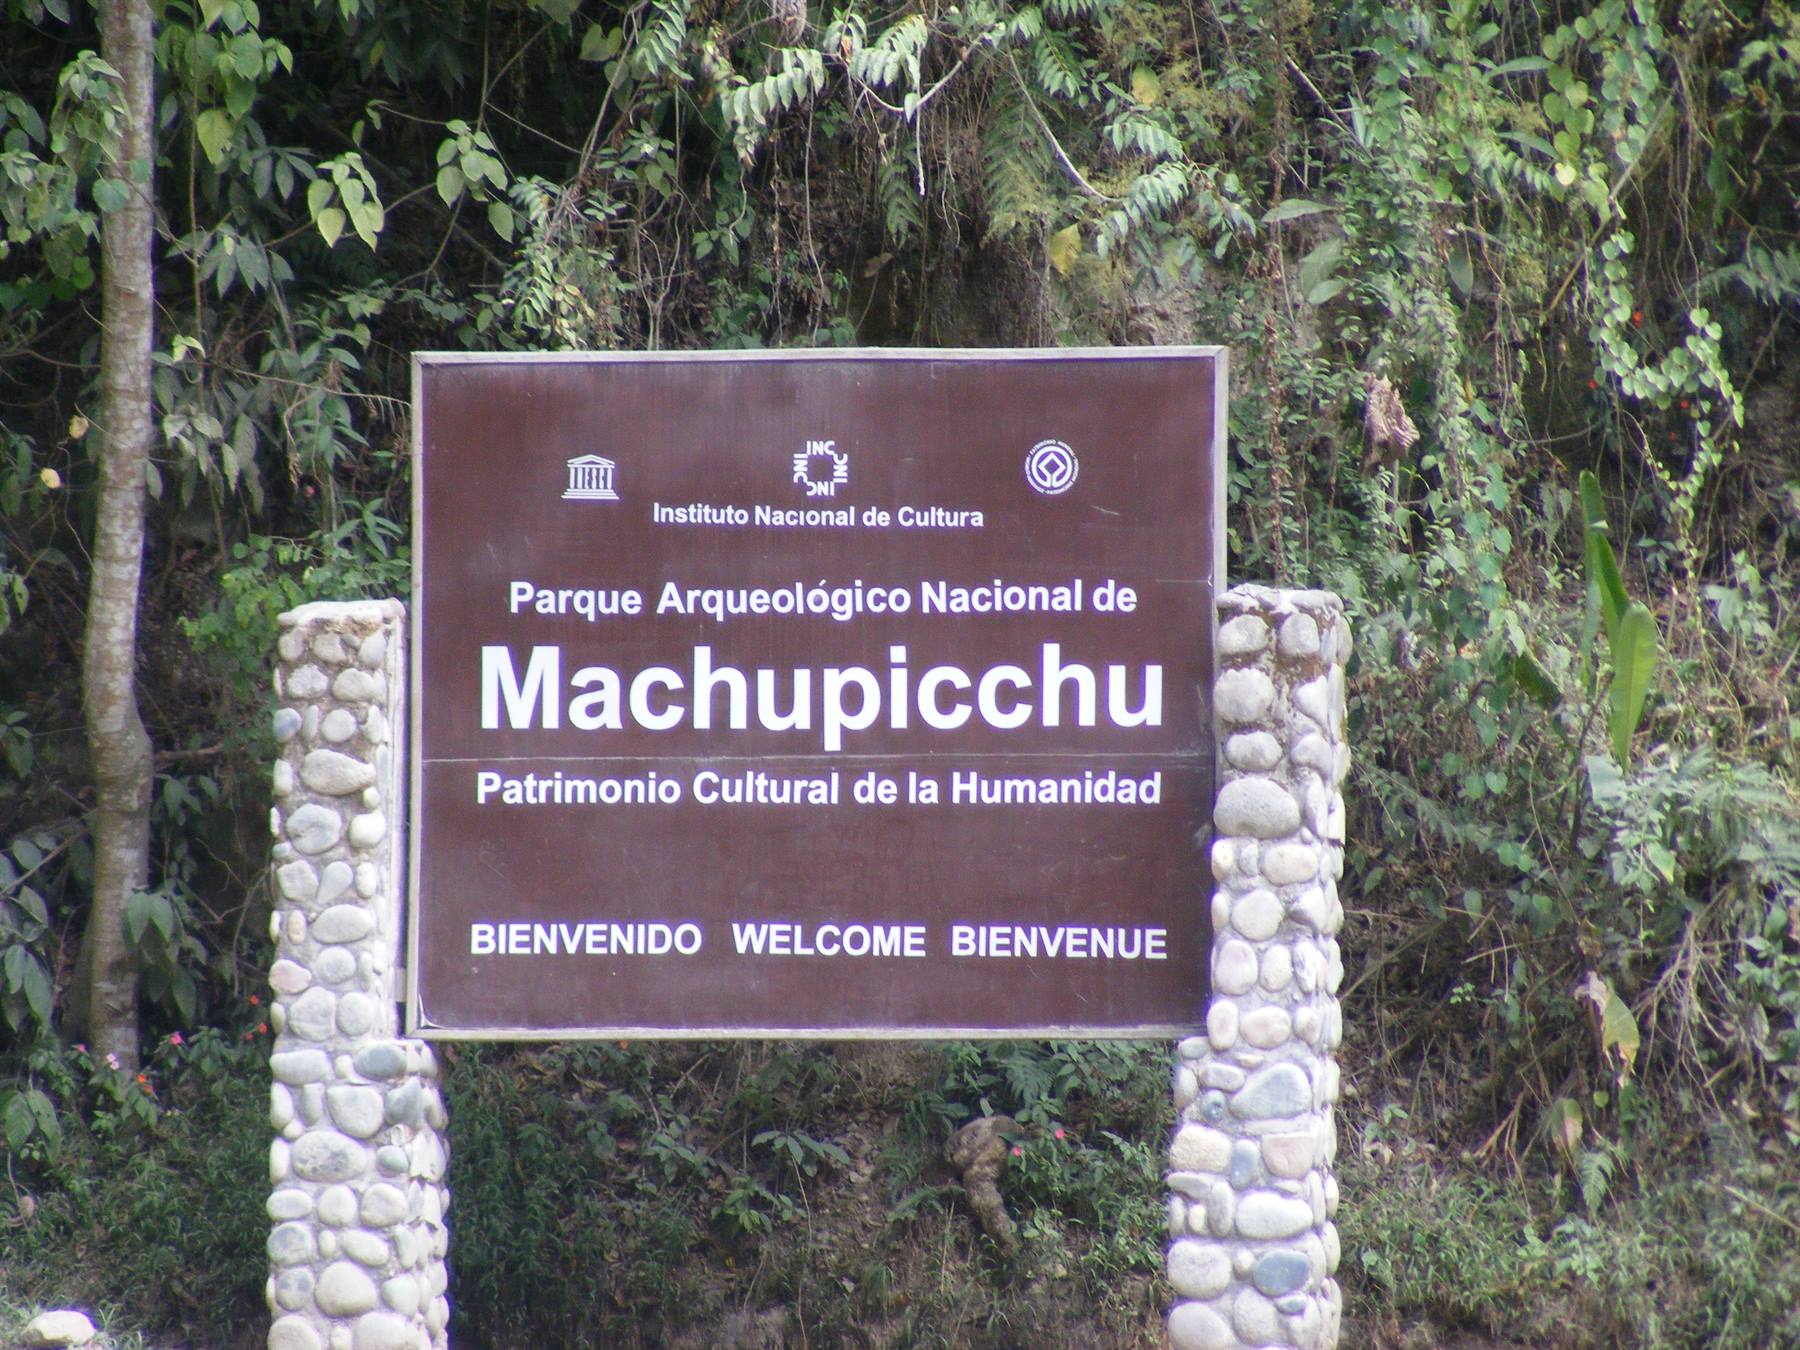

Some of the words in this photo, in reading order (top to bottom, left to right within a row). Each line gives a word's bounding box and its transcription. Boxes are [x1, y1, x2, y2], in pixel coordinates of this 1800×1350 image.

[806, 440, 836, 456] INC
[793, 453, 808, 483] INC
[833, 453, 848, 483] INC
[653, 502, 749, 525] Instituto
[754, 505, 855, 527] Nacional
[862, 506, 891, 527] de
[897, 506, 985, 528] Cultura
[510, 581, 642, 623] Parque
[656, 579, 912, 623] Arqueológico
[921, 578, 1083, 614] Nacional
[1092, 579, 1138, 613] de
[481, 642, 1163, 752] Machupicchu
[477, 771, 682, 805] Patrimonio
[692, 770, 839, 805] Cultural
[853, 771, 898, 805] de
[908, 771, 939, 805] la
[952, 770, 1162, 805] Humanidad
[470, 923, 702, 955] BIENVENIDO
[731, 923, 926, 957] WELCOME
[951, 925, 1167, 961] BIENVENUE
